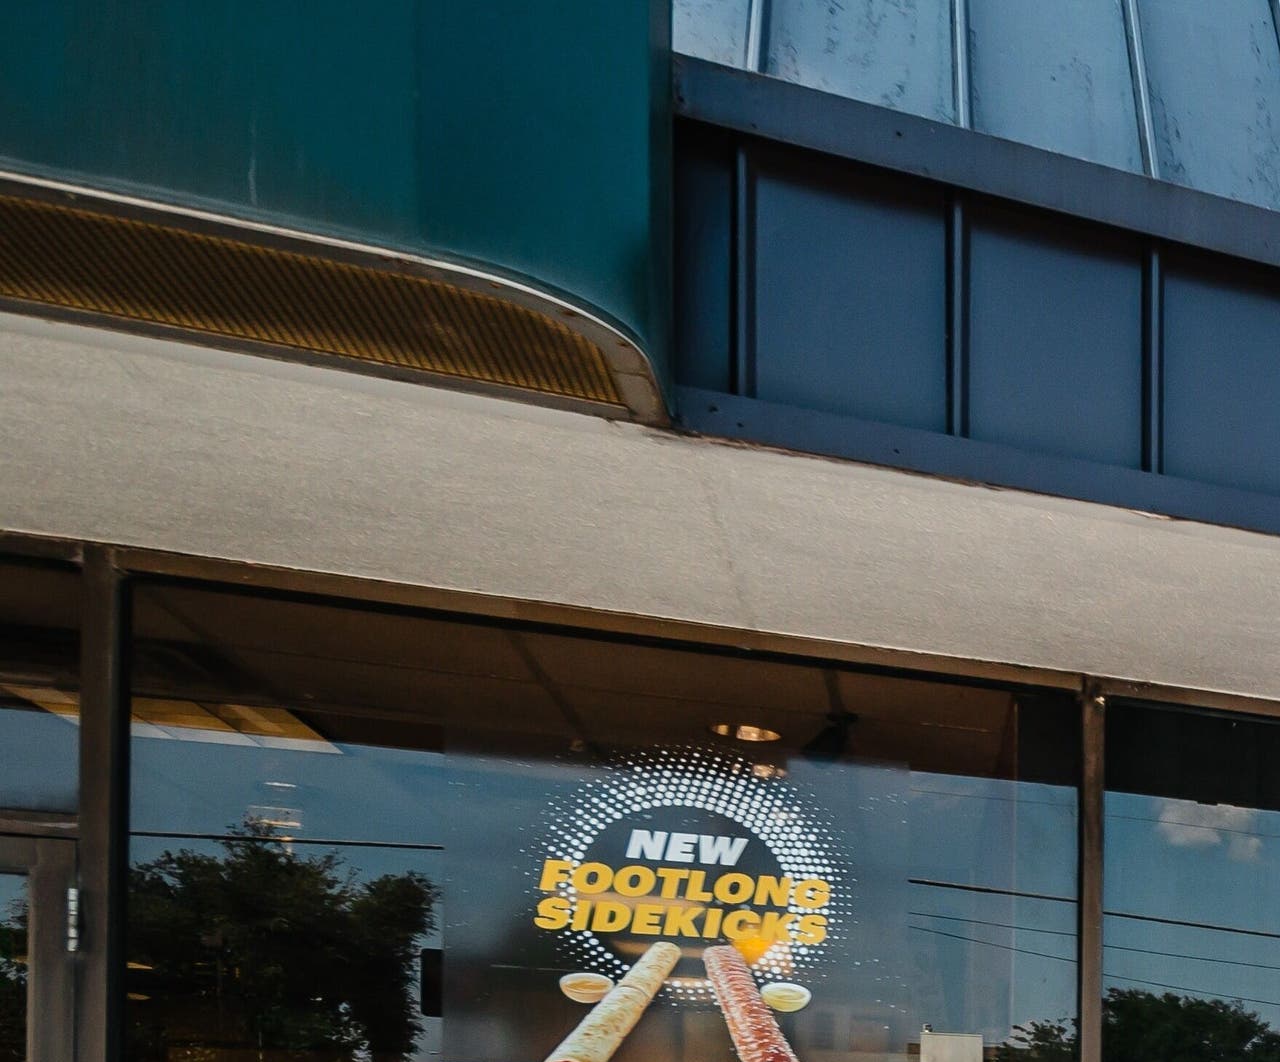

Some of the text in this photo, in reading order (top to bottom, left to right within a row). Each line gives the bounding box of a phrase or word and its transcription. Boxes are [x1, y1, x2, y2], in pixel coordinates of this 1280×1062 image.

[625, 829, 748, 866] NEW
[539, 859, 831, 909] FOOTLONG
[534, 896, 828, 945] SIDEKICKS
